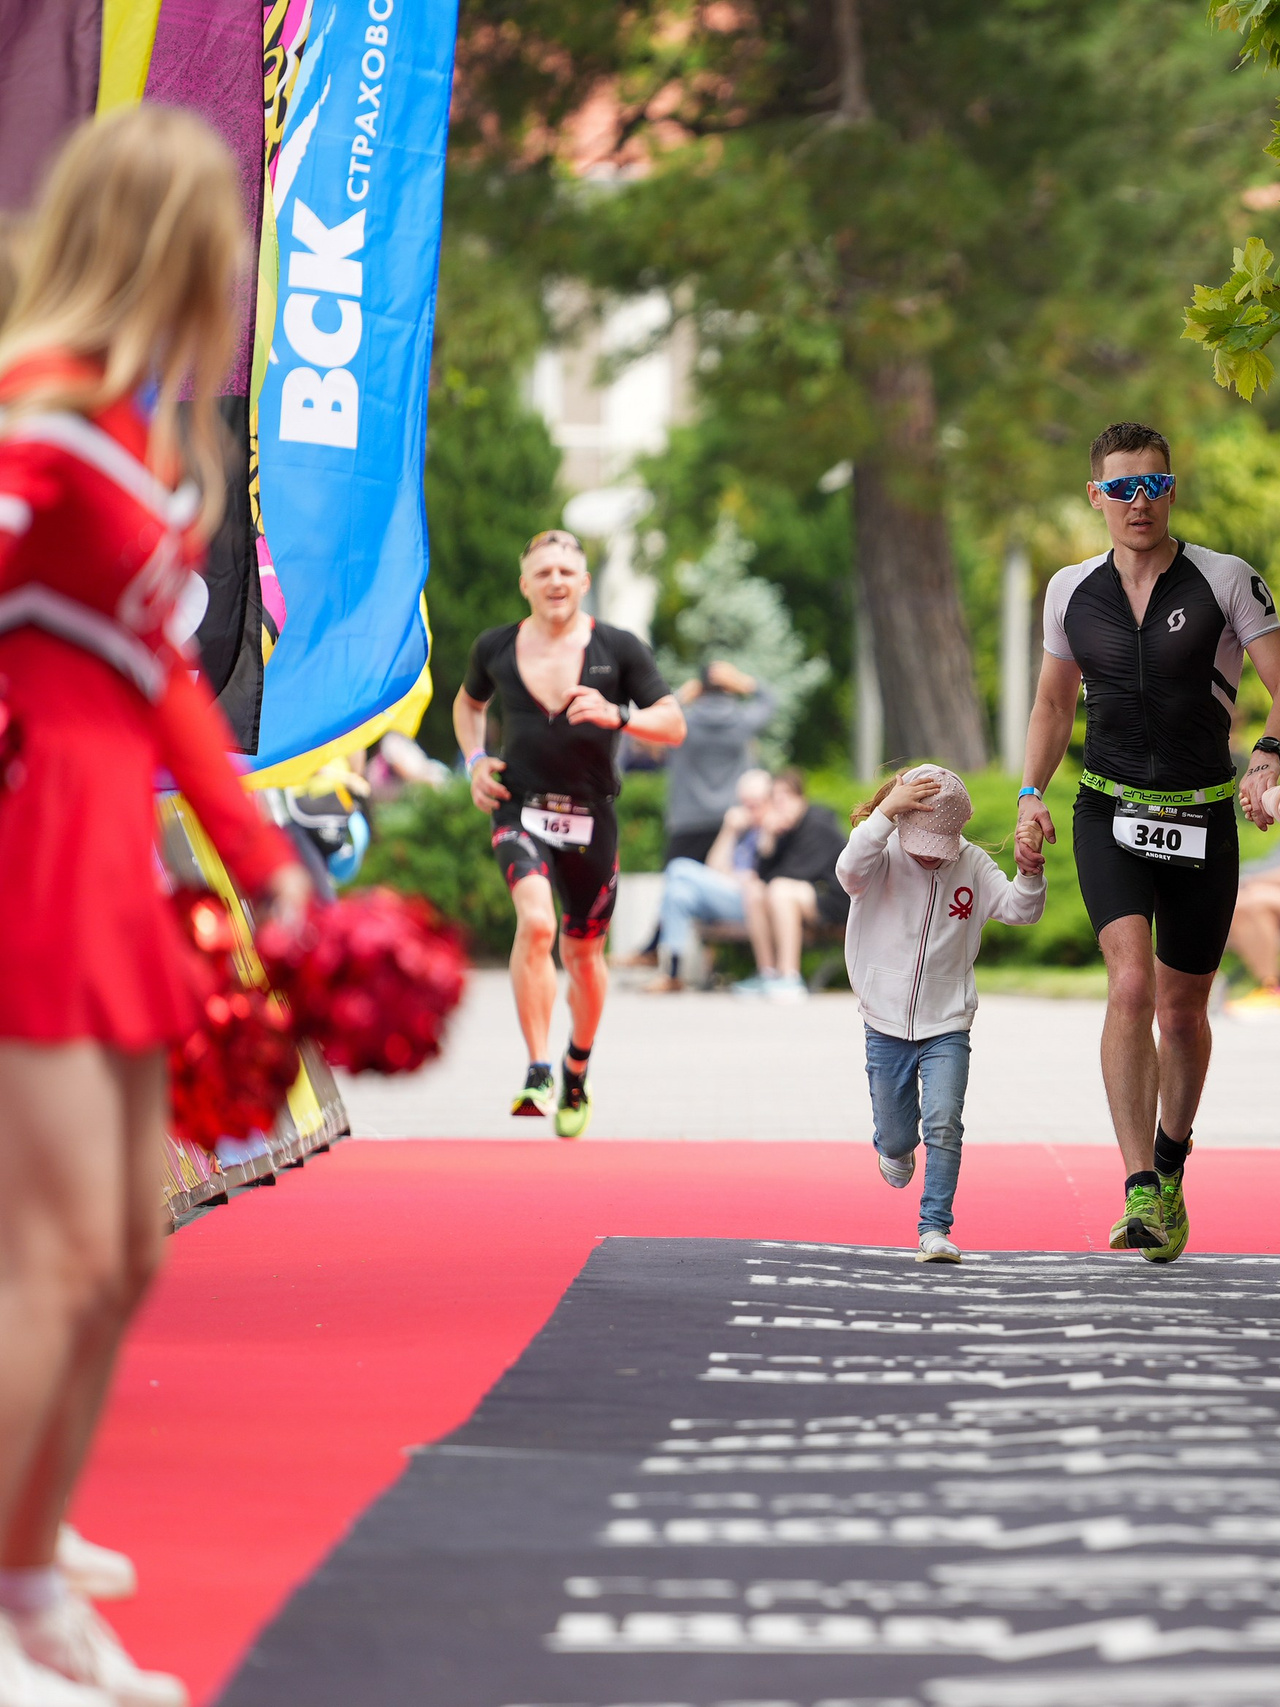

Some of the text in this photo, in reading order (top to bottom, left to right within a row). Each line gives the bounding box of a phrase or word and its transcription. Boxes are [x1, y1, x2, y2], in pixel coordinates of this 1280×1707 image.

[279, 197, 366, 449] ВСК
[1247, 763, 1269, 776] 340
[1123, 790, 1193, 803] POWERUP
[542, 817, 570, 834] 165
[1134, 824, 1182, 851] 340
[1145, 851, 1171, 861] ANDREY
